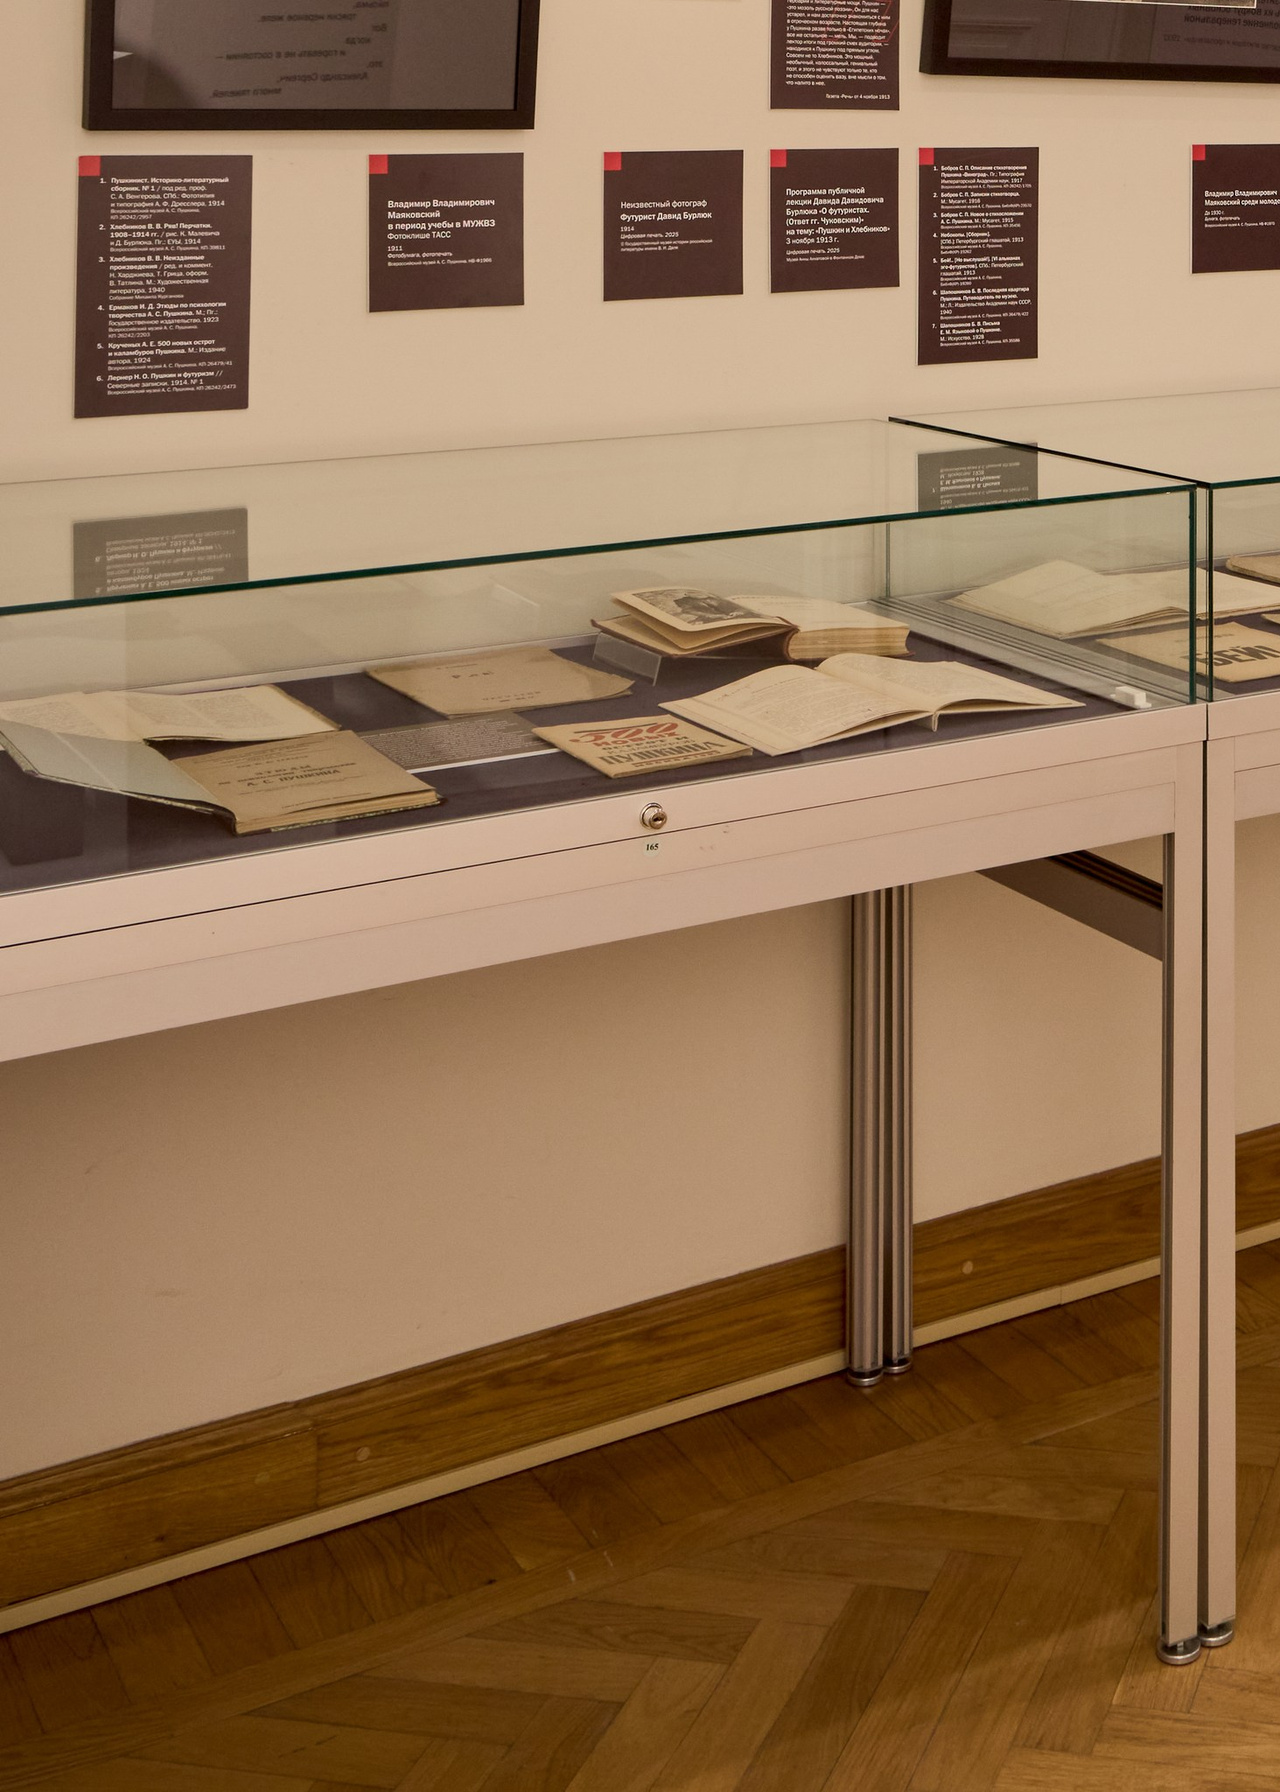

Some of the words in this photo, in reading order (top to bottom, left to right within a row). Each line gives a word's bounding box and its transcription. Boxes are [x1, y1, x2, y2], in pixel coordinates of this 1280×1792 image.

[785, 187, 828, 197] Программа
[827, 186, 866, 196] публичной
[387, 199, 432, 210] Владимир
[431, 198, 496, 208] Владимирович
[620, 199, 671, 209] Неизвестный
[670, 198, 708, 209] фотограф
[785, 198, 813, 207] лекции
[812, 196, 841, 207] Давида
[839, 196, 885, 206] Давидовича
[387, 209, 441, 220] Маяковский
[619, 212, 657, 223] Футурист
[655, 211, 683, 222] Давид
[682, 210, 713, 221] Бурлюк
[387, 223, 394, 231] в
[394, 222, 427, 231] период
[427, 220, 455, 231] учебы
[454, 221, 462, 229] в
[462, 218, 496, 228] МУЖВЗ
[386, 232, 431, 241] Фотоклише
[430, 229, 452, 239] ТАСС
[785, 236, 792, 245] 3
[791, 236, 816, 245] ноября
[815, 235, 834, 244] 1913
[387, 244, 403, 252] 1911
[646, 842, 659, 851] 165
